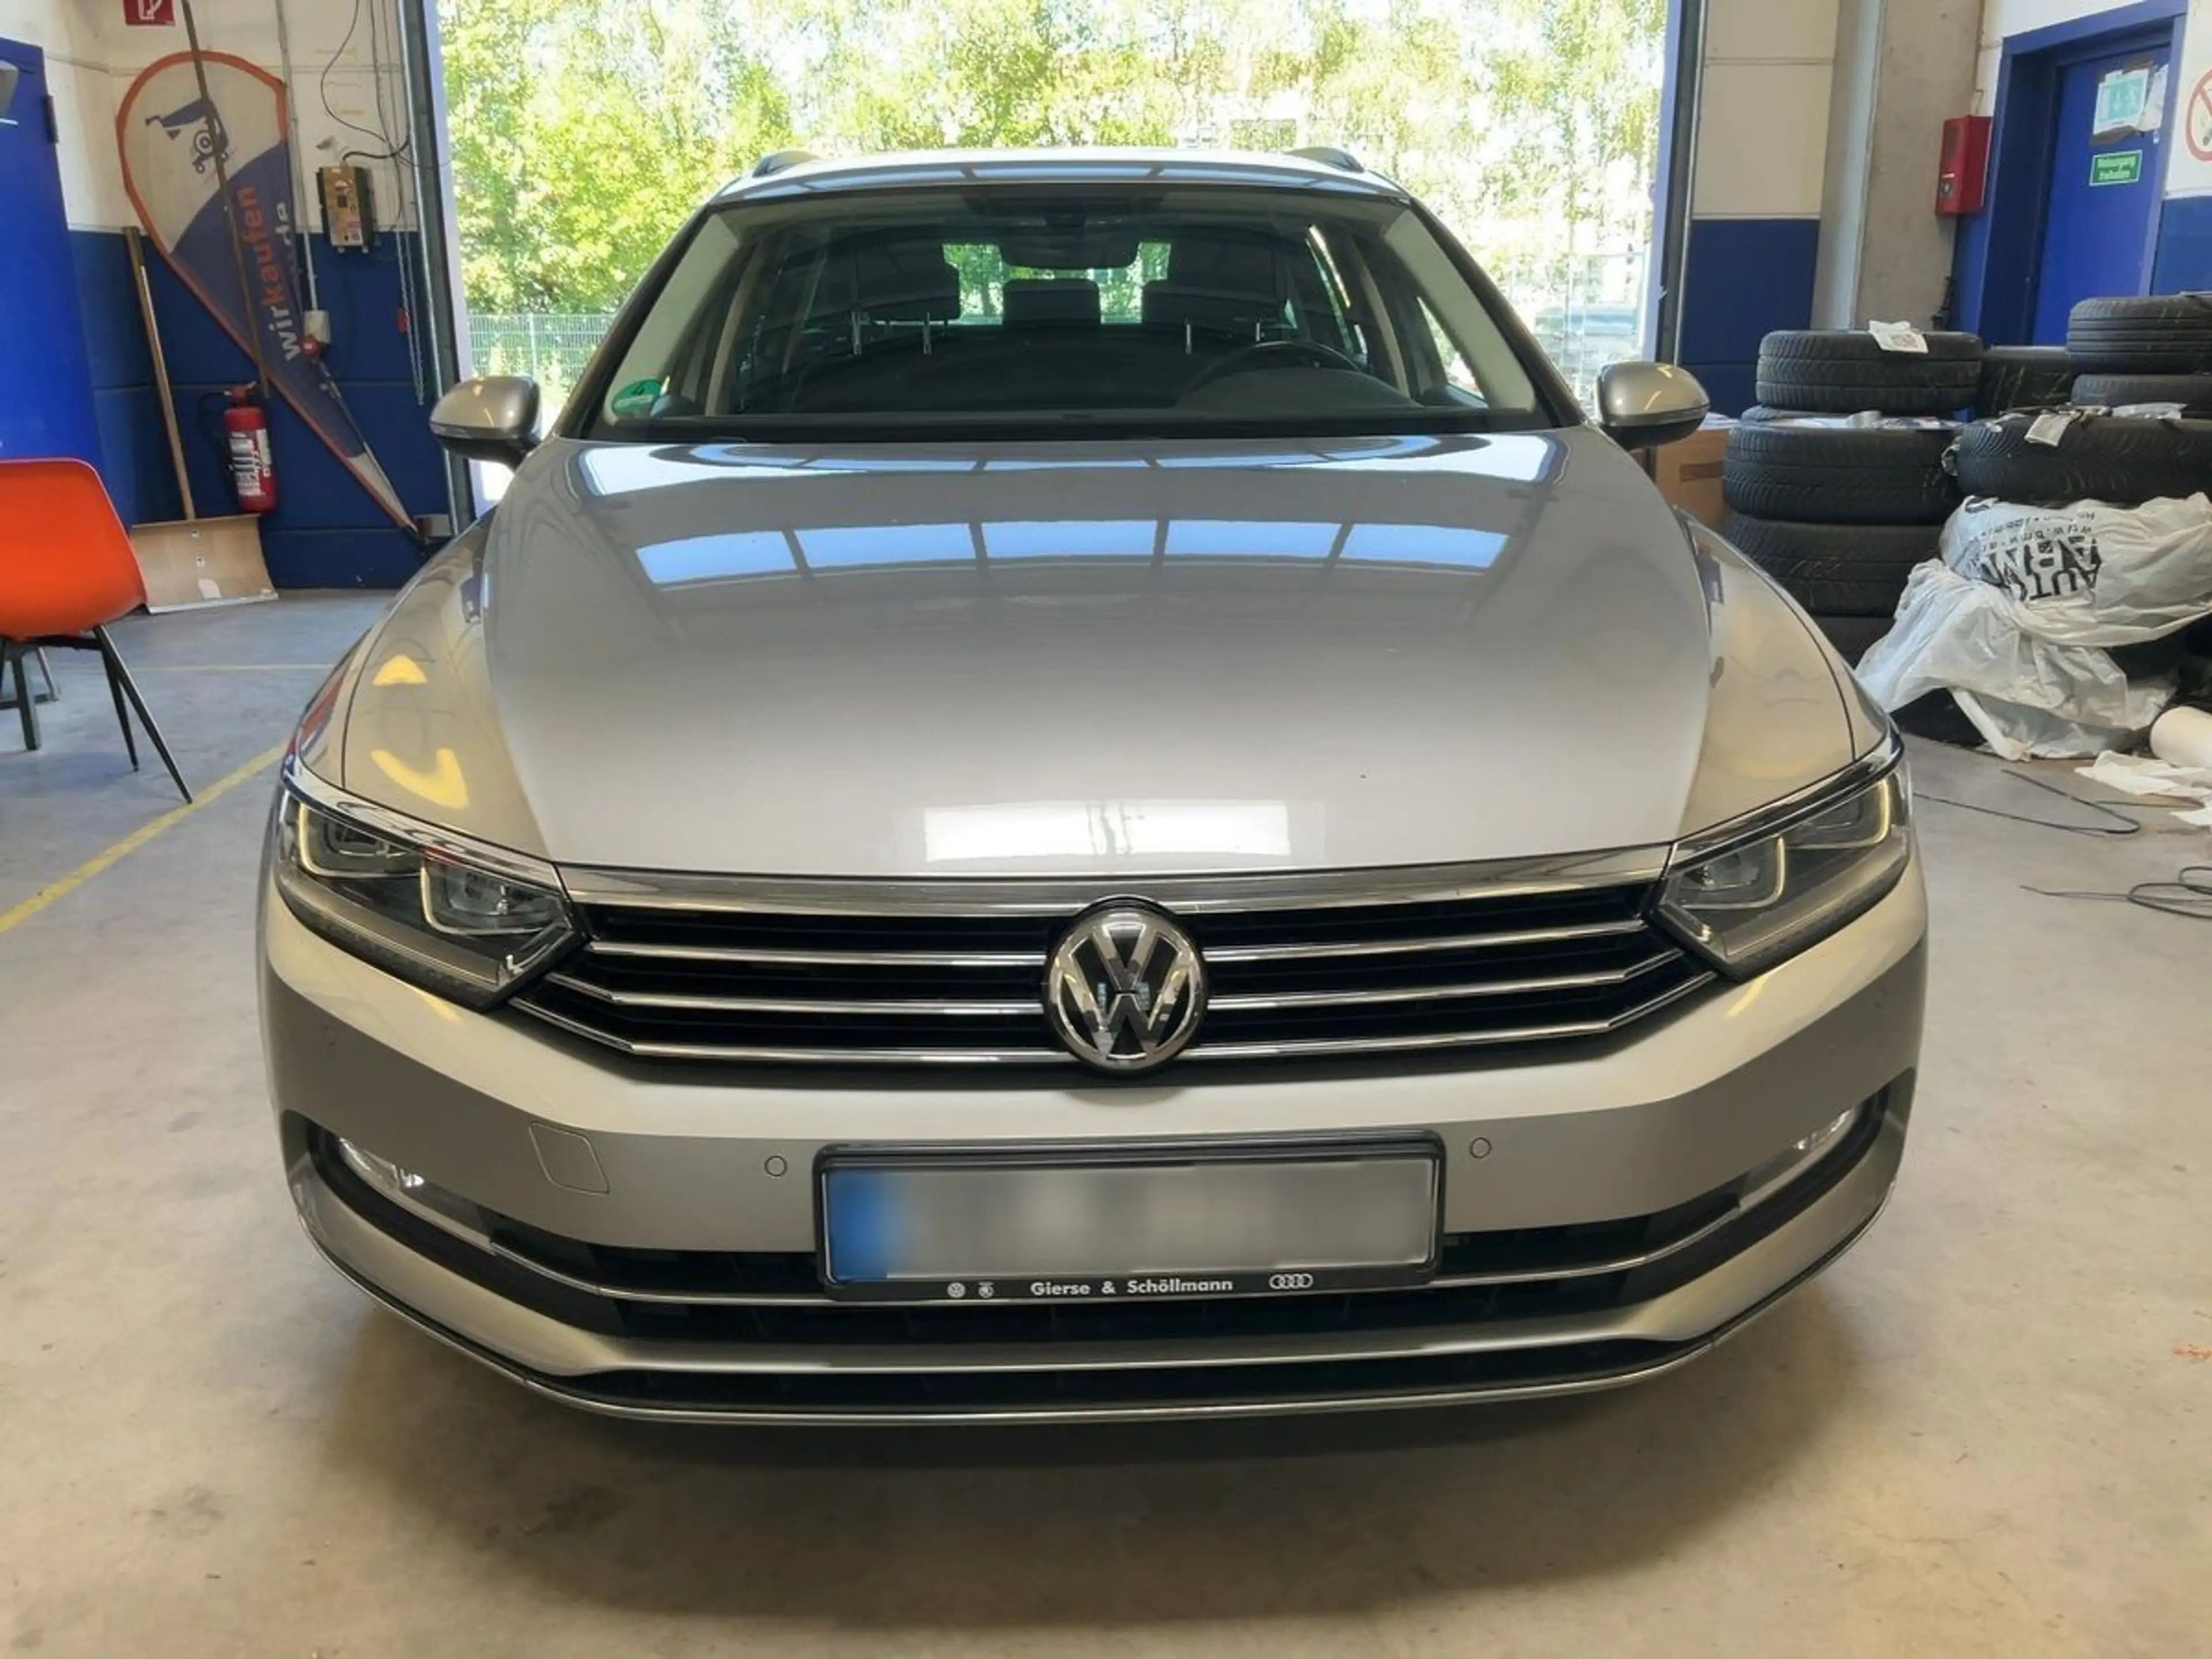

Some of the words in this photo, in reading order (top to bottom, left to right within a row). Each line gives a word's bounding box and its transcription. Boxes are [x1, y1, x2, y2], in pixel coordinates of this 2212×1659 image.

[1031, 1281, 1090, 1296] Gierse
[1101, 1281, 1116, 1294] &
[1127, 1277, 1233, 1294] Schöllmann
